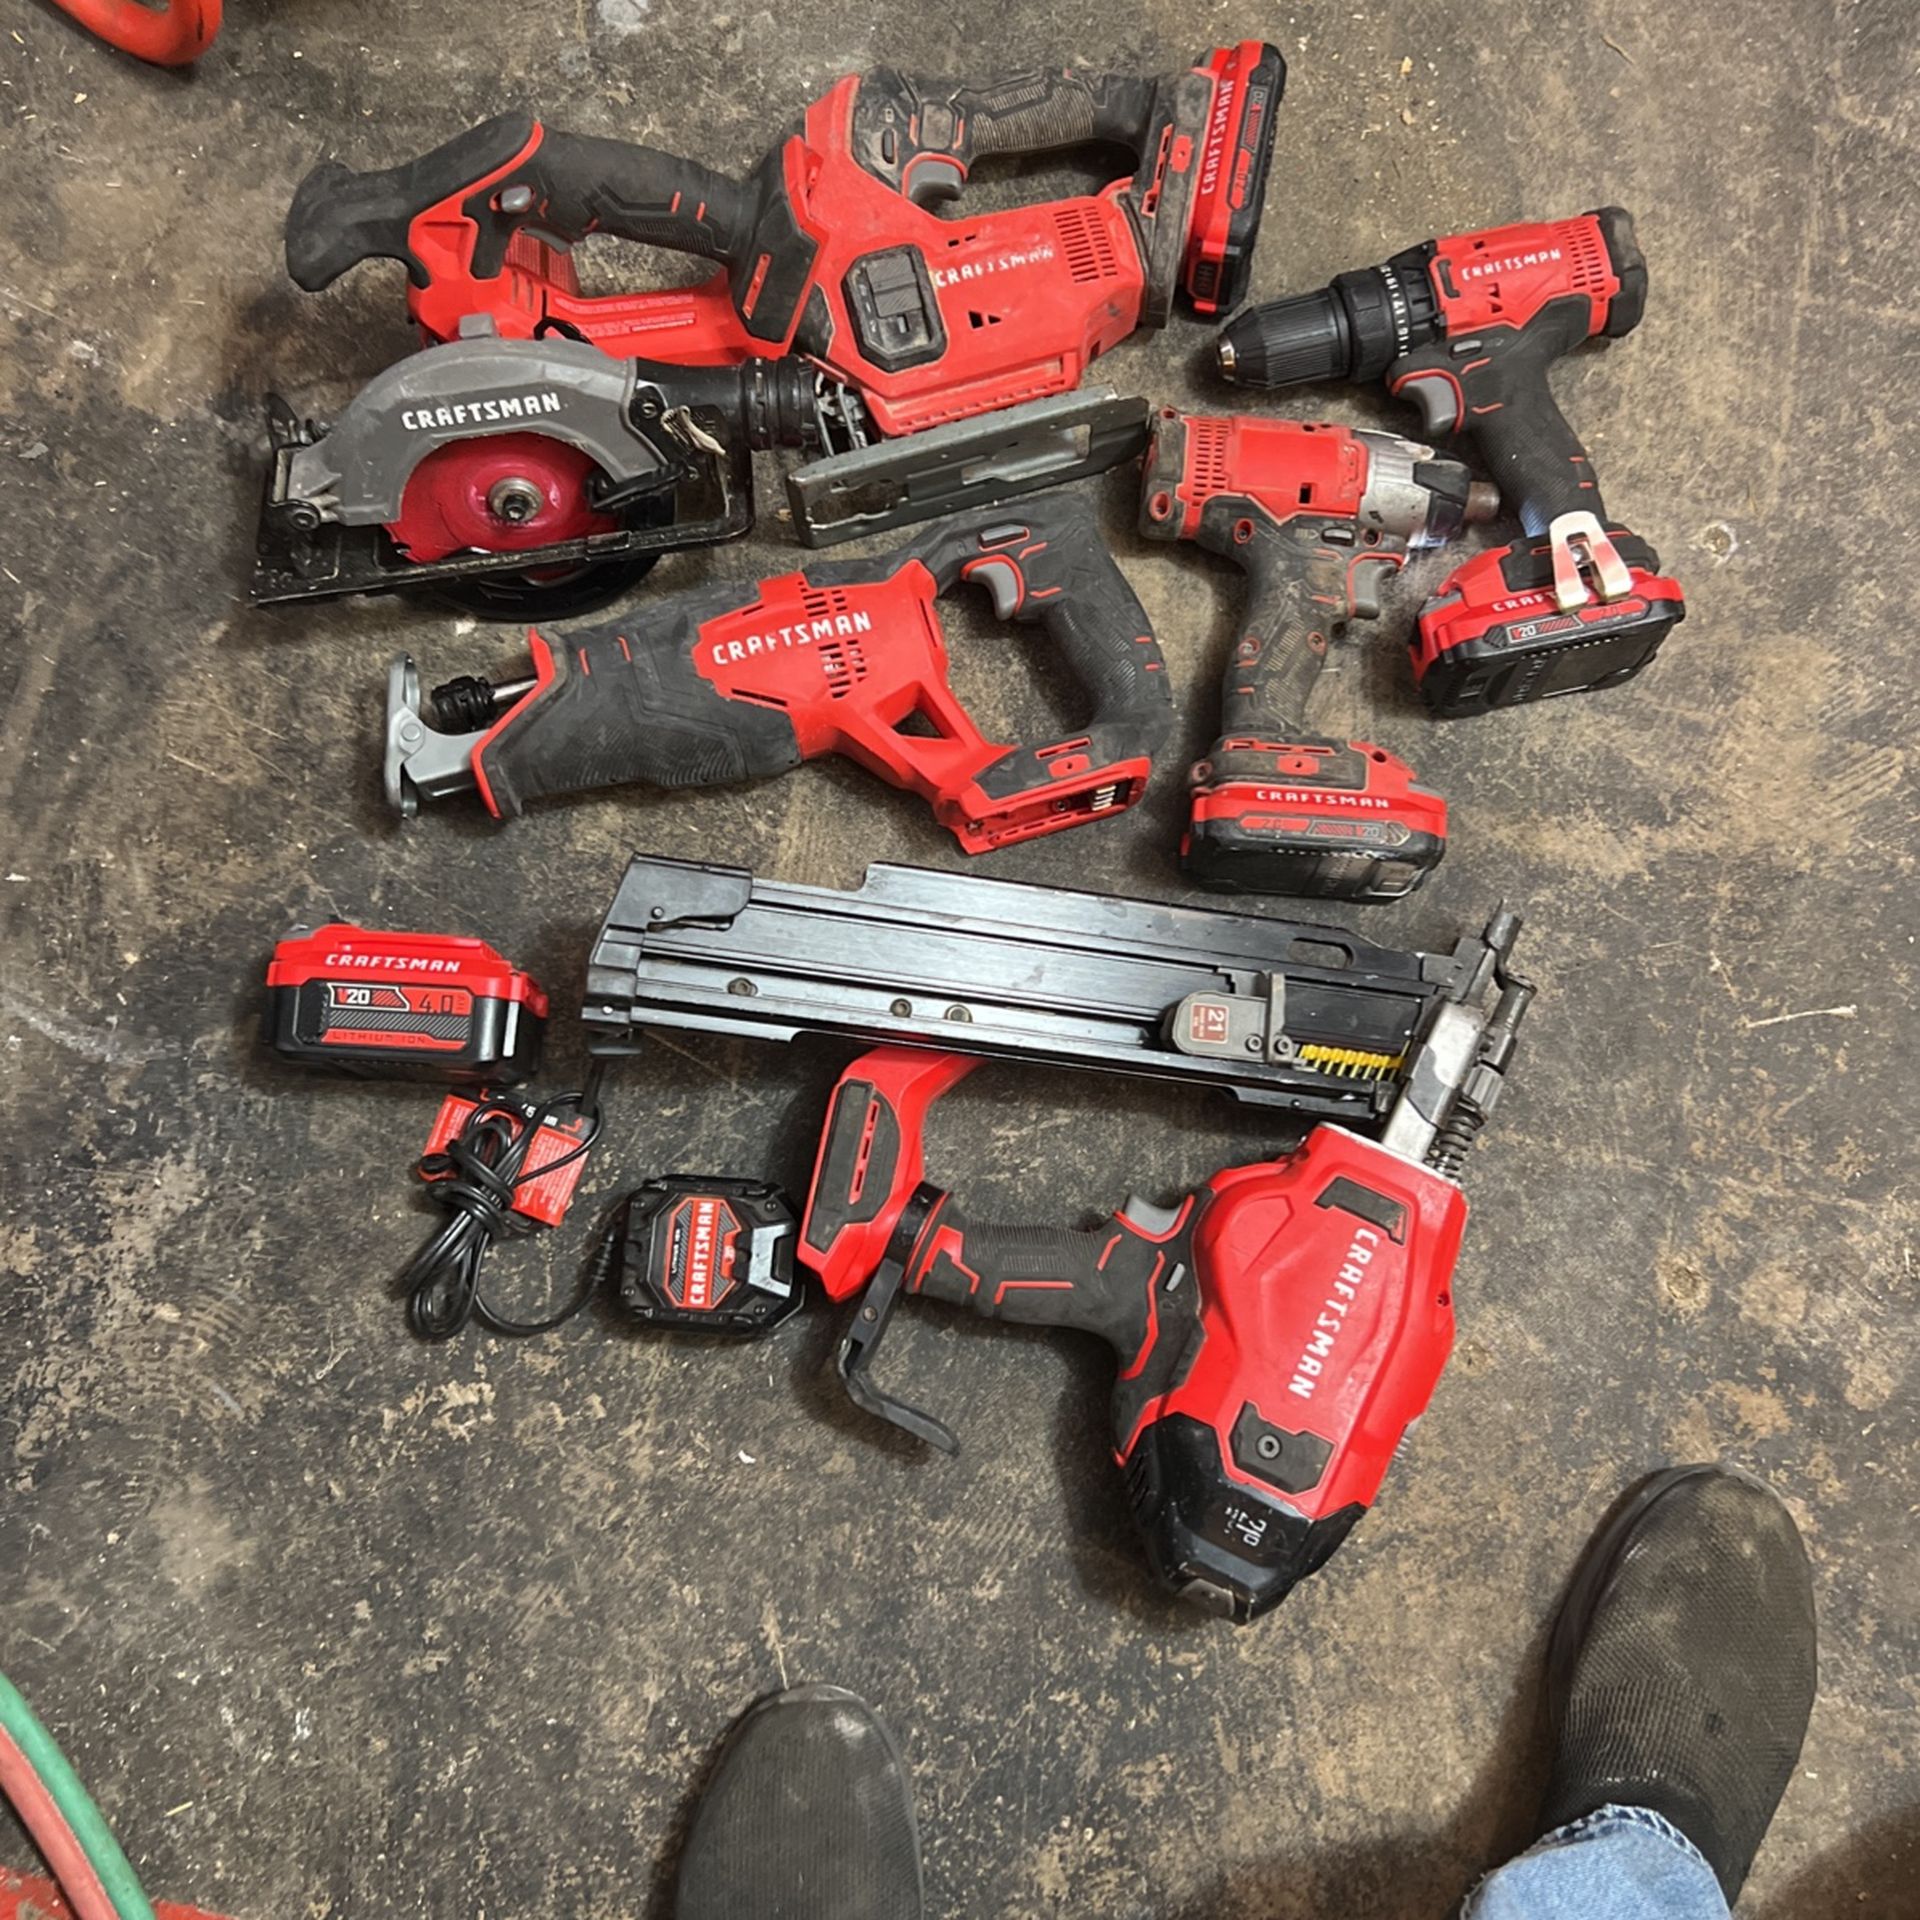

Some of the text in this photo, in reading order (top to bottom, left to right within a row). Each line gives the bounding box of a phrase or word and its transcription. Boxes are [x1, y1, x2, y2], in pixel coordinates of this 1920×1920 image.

[1201, 80, 1235, 195] CRAFTSMAN
[1461, 248, 1561, 281] CRAFTSMAN
[402, 392, 561, 430] CRAFTSMAN
[712, 611, 872, 665] CRAFTSMAN
[1256, 790, 1390, 809] CRAFTSMAN
[325, 954, 461, 973] CRAFTSMAN
[337, 988, 370, 1005] V20
[690, 1202, 714, 1304] CRAFTSMAN
[1288, 1228, 1379, 1399] CRAFTSMAN
